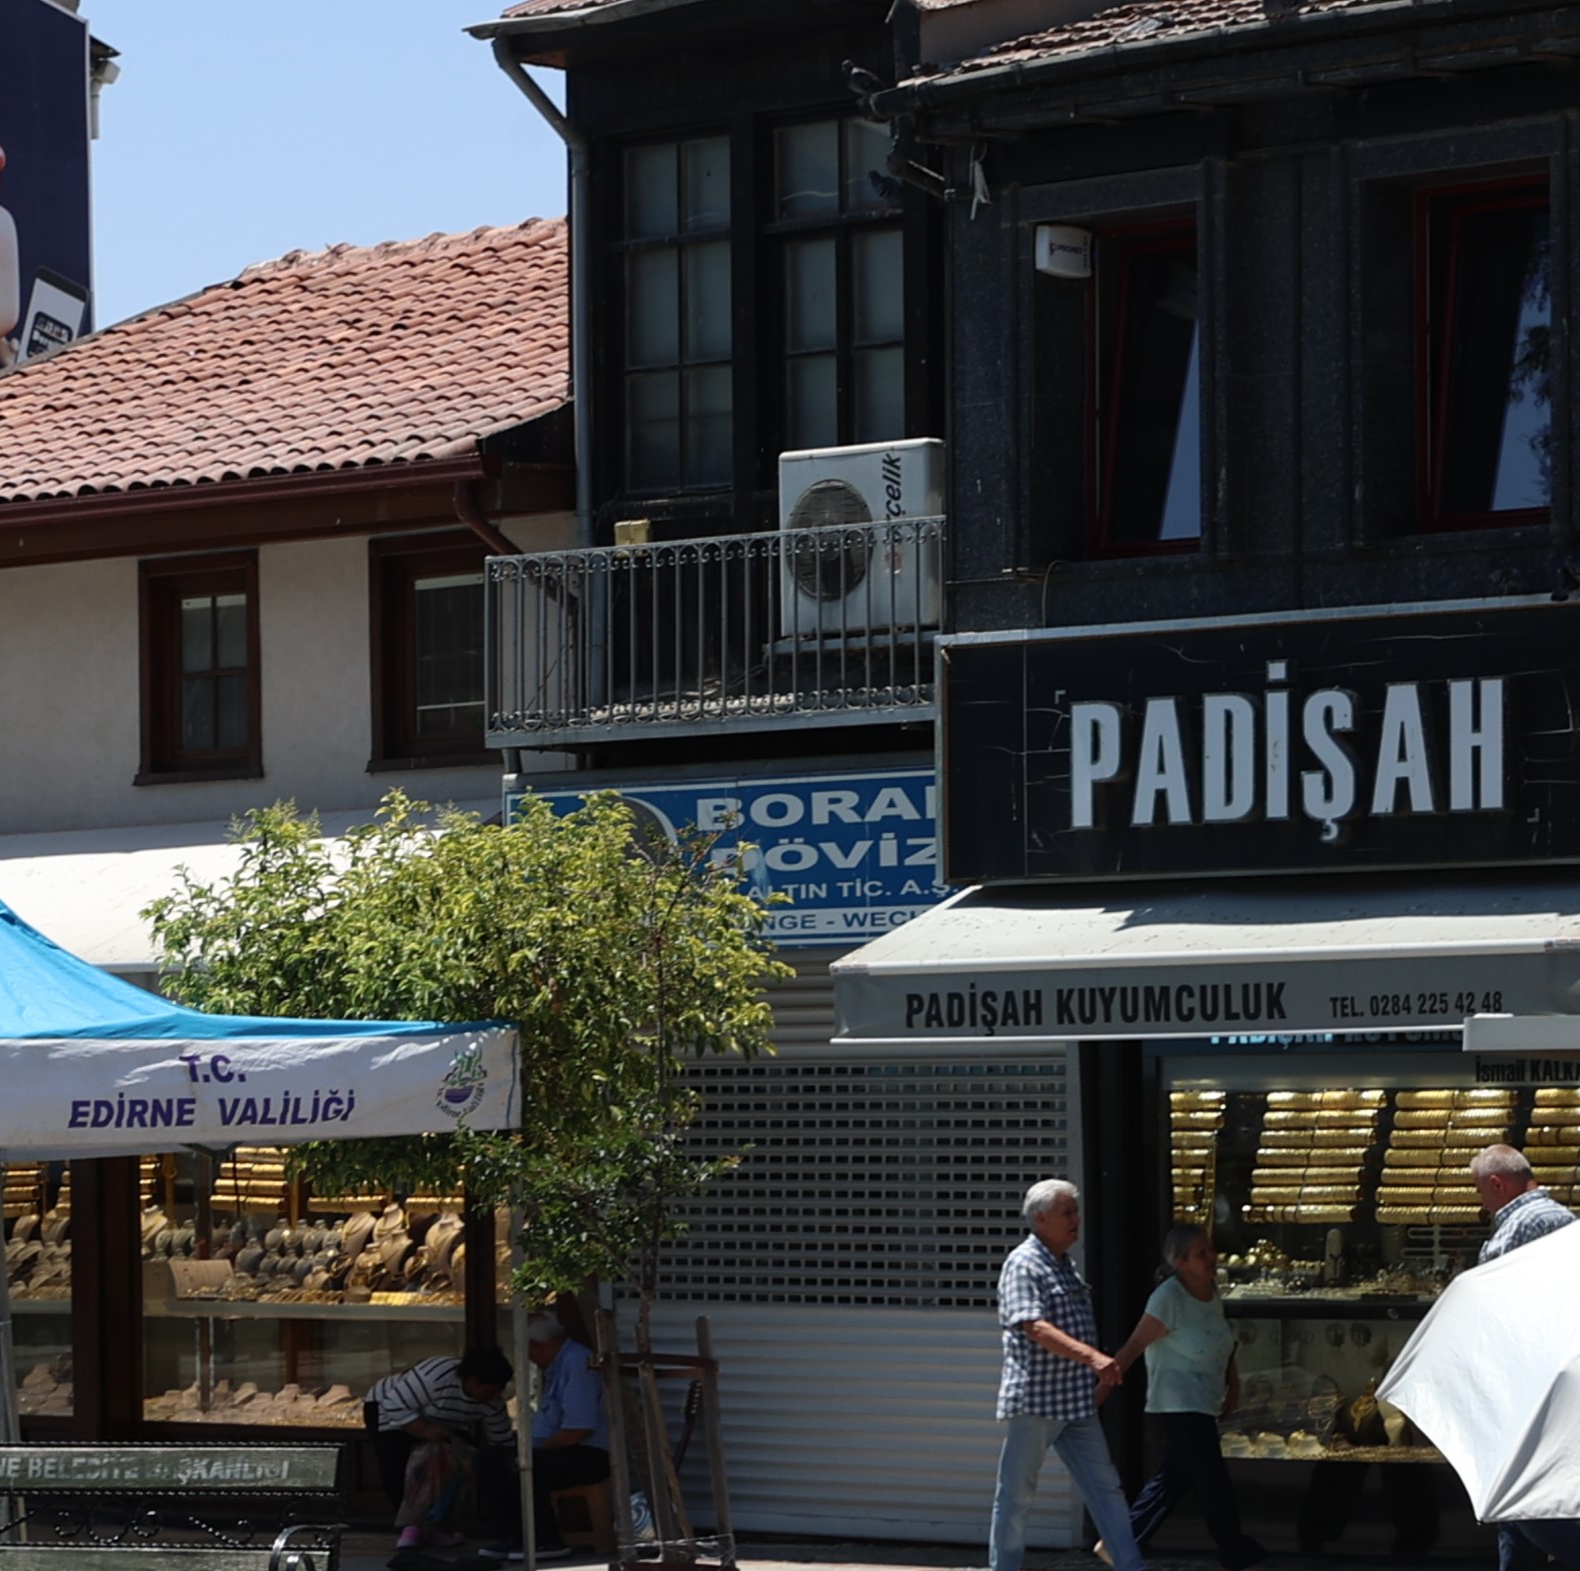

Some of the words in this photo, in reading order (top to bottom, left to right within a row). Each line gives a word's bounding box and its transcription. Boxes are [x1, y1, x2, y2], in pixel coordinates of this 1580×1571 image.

[1070, 659, 1505, 842] PADİŞAH
[696, 786, 936, 832] BORA
[836, 877, 892, 898] TİC.
[905, 981, 1043, 1037] PADİŞAH
[1056, 981, 1288, 1026] KUYUMCULUK
[1330, 995, 1365, 1018] TEL.
[1369, 994, 1411, 1017] 0284
[1418, 992, 1449, 1016] 225
[1455, 991, 1476, 1014] 42
[1481, 990, 1503, 1014] 48
[179, 1054, 247, 1083] T.C.
[1475, 1055, 1526, 1083] İsmail
[68, 1092, 197, 1129] EDİRNE
[217, 1088, 356, 1127] VALİLİĞİ
